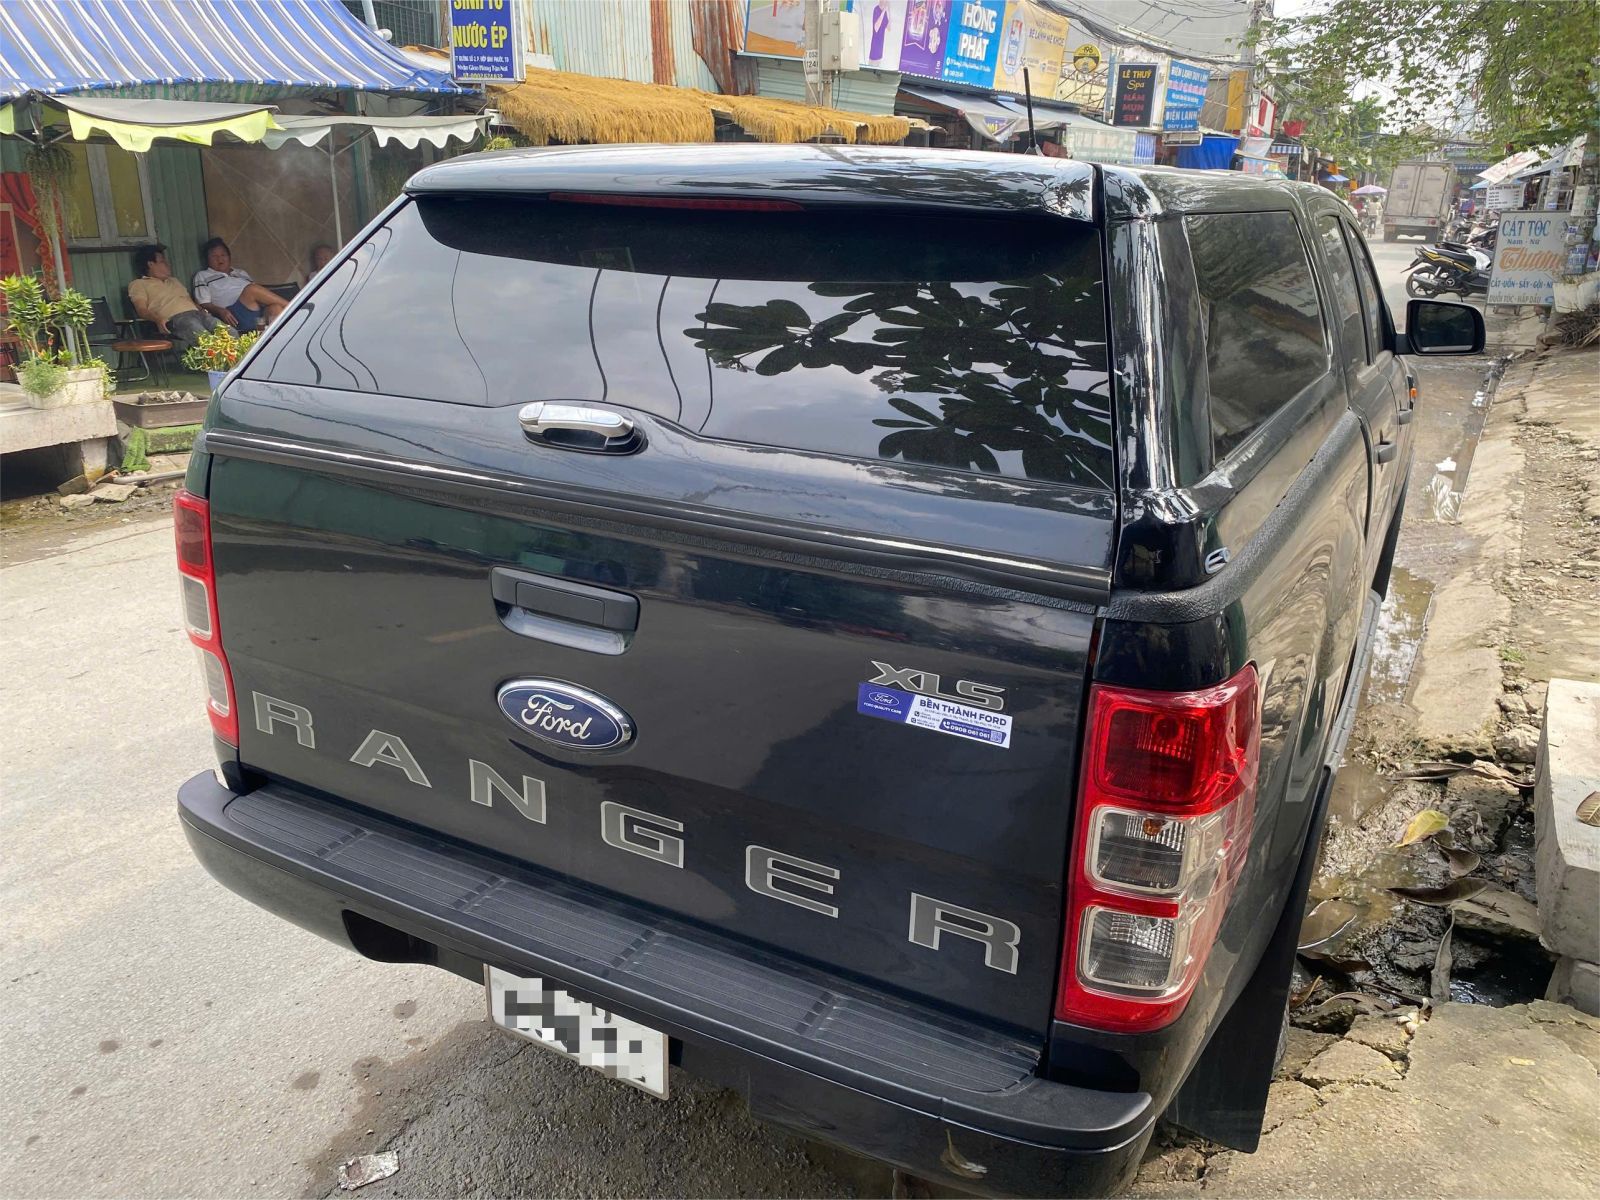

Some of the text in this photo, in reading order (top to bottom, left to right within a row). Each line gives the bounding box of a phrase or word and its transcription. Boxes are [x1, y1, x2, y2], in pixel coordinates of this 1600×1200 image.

[453, 21, 508, 48] NƯỚC ÉP
[958, 31, 989, 61] PHÁT
[1127, 80, 1144, 90] Spa
[868, 660, 1006, 711] XLS
[874, 692, 894, 704] Ford
[521, 694, 592, 740] Ford
[942, 704, 977, 720] THÀNH
[979, 713, 1007, 726] FORD
[950, 724, 967, 733] 0908
[252, 690, 1022, 975] RANGER
